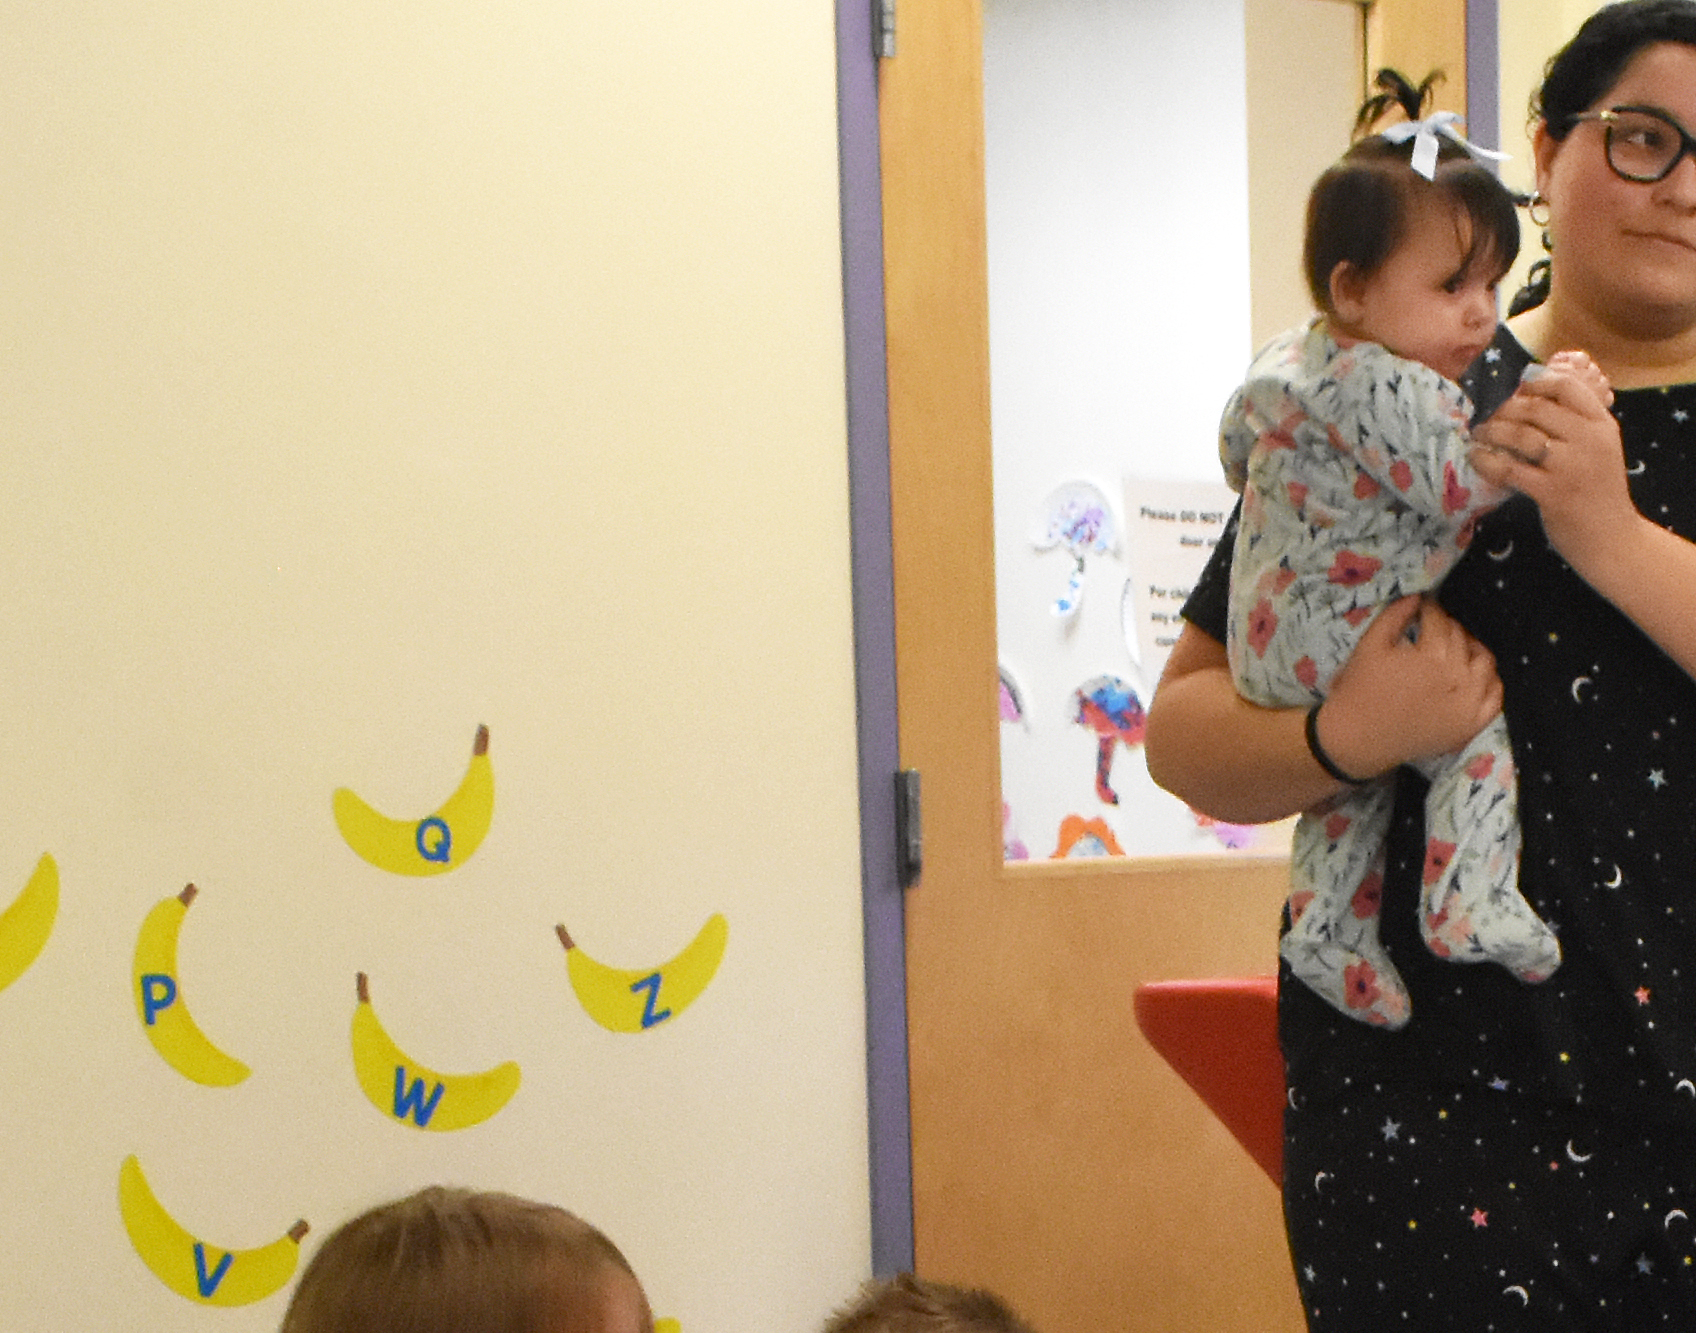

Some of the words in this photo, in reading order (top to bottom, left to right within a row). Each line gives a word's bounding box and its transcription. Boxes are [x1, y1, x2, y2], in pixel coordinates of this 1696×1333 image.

[1200, 512, 1224, 523] NOT
[416, 818, 451, 862] Q
[142, 974, 176, 1025] P
[632, 974, 670, 1028] Z
[394, 1067, 444, 1126] W
[194, 1244, 232, 1297] V
